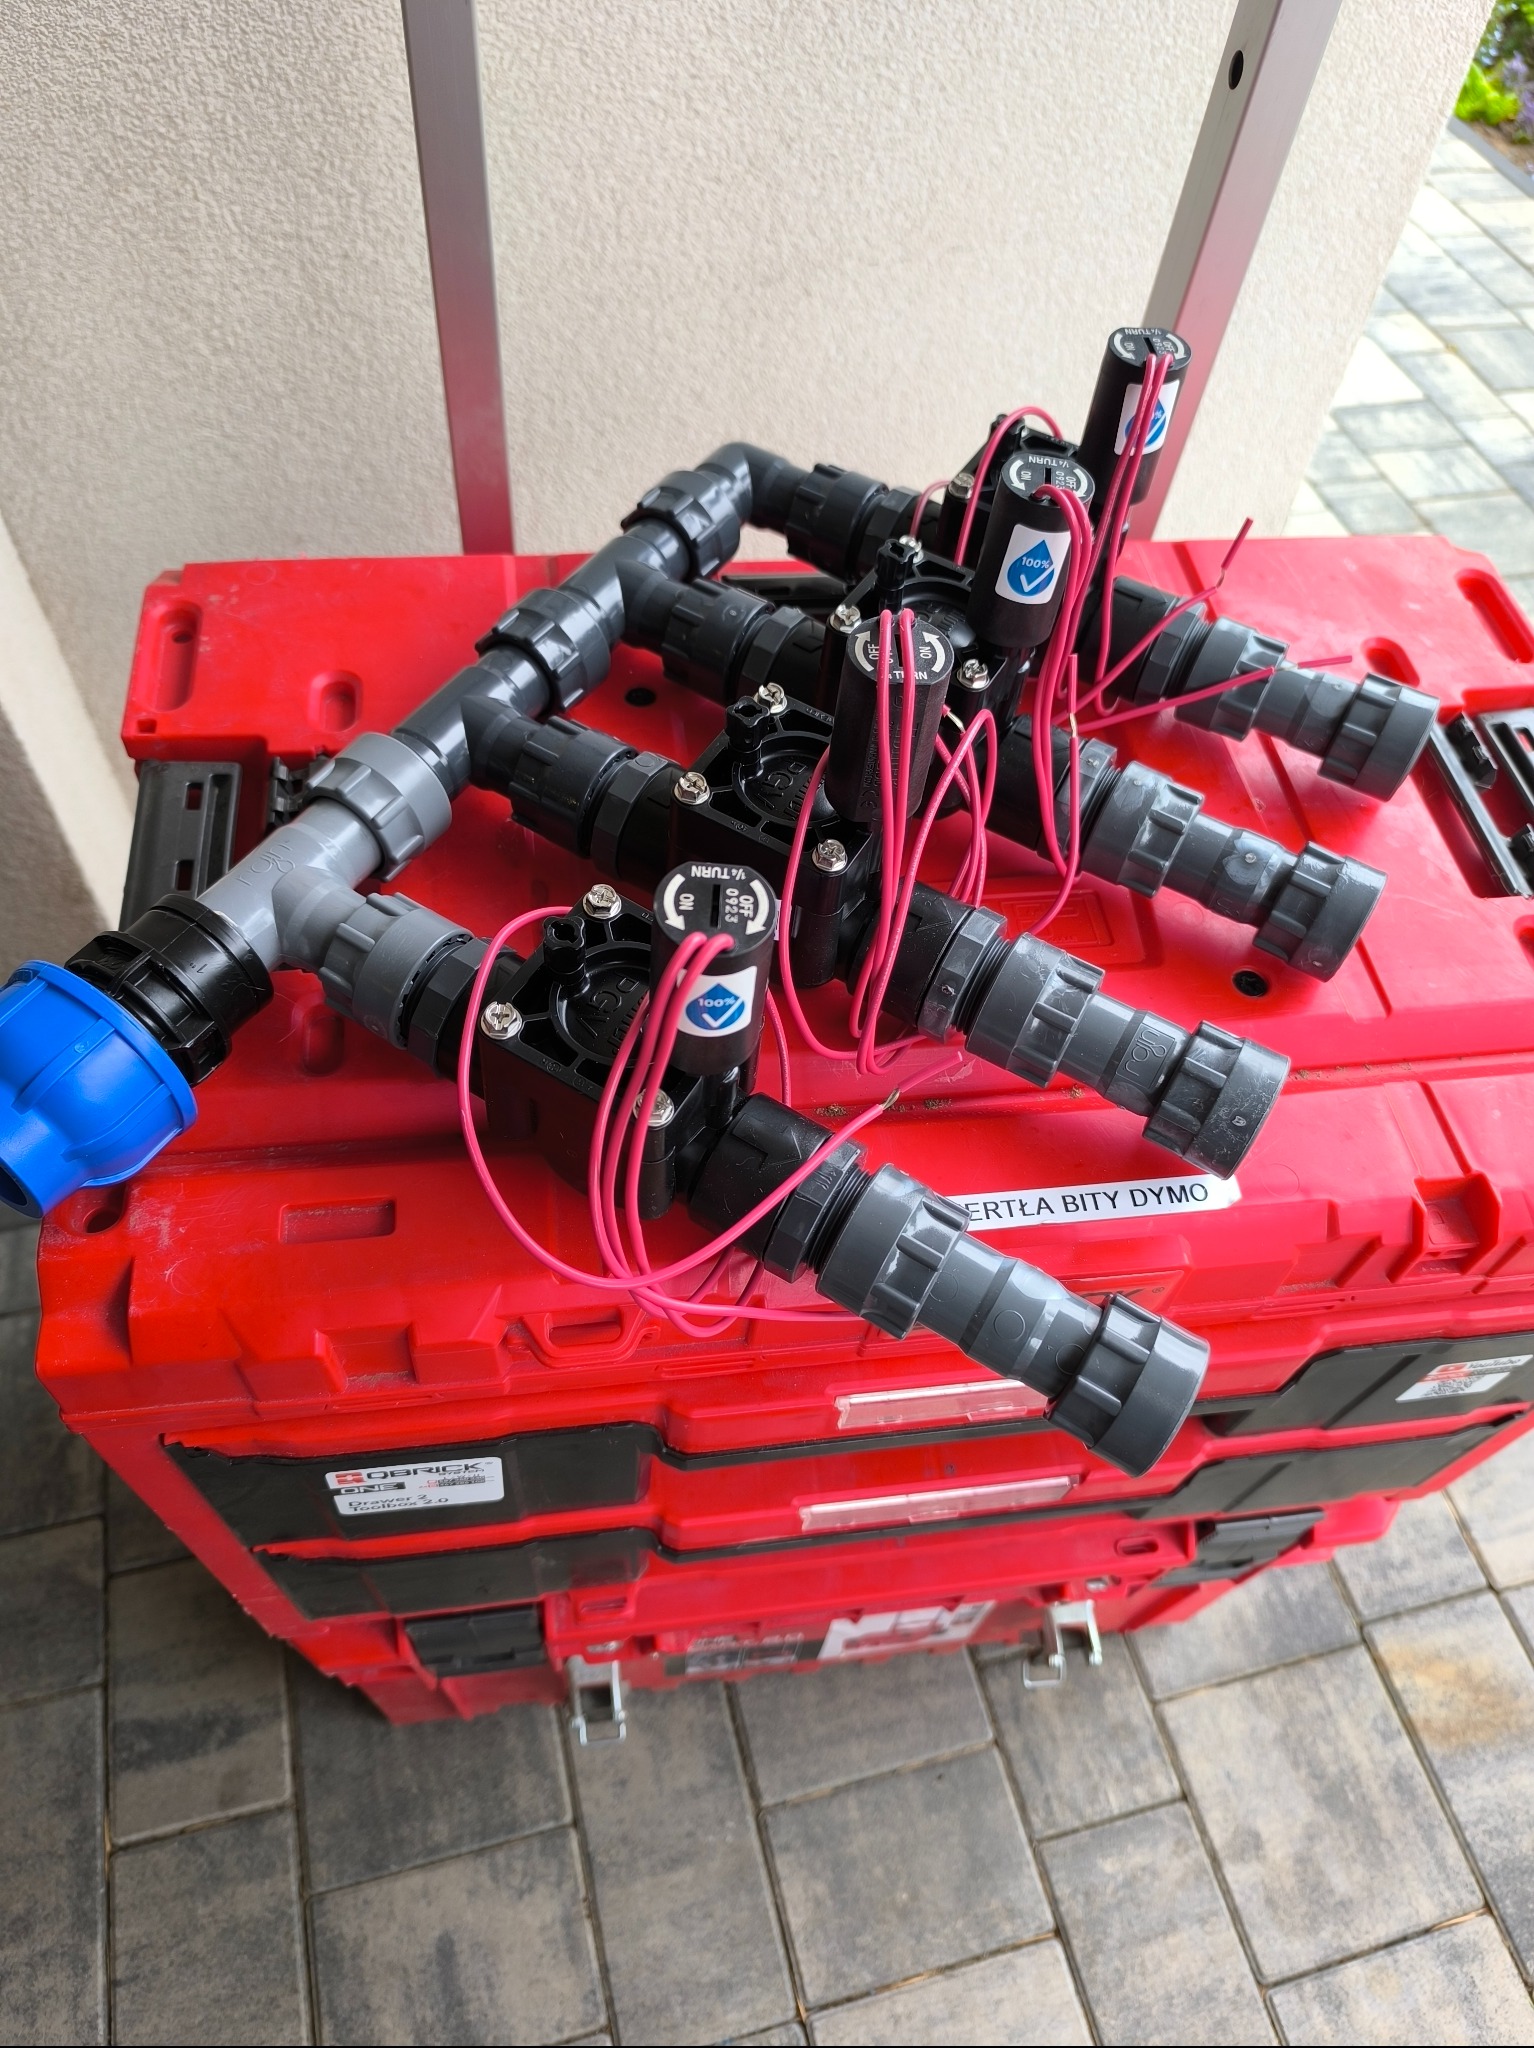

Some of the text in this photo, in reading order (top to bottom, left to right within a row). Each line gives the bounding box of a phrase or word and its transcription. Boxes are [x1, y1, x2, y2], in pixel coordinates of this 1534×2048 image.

[1028, 456, 1058, 467] TURN
[1020, 470, 1032, 481] ON
[1021, 555, 1051, 569] 100%
[919, 646, 932, 659] ON
[691, 865, 731, 879] TURN
[679, 893, 695, 911] ON
[724, 888, 740, 923] 0923
[738, 895, 755, 919] OFF
[697, 997, 736, 1008] 100%
[959, 1183, 1209, 1221] ERTŁA BITY DYMO
[366, 1461, 483, 1479] QBRICK
[349, 1496, 412, 1507] Drawer
[350, 1500, 418, 1512] Toolbox
